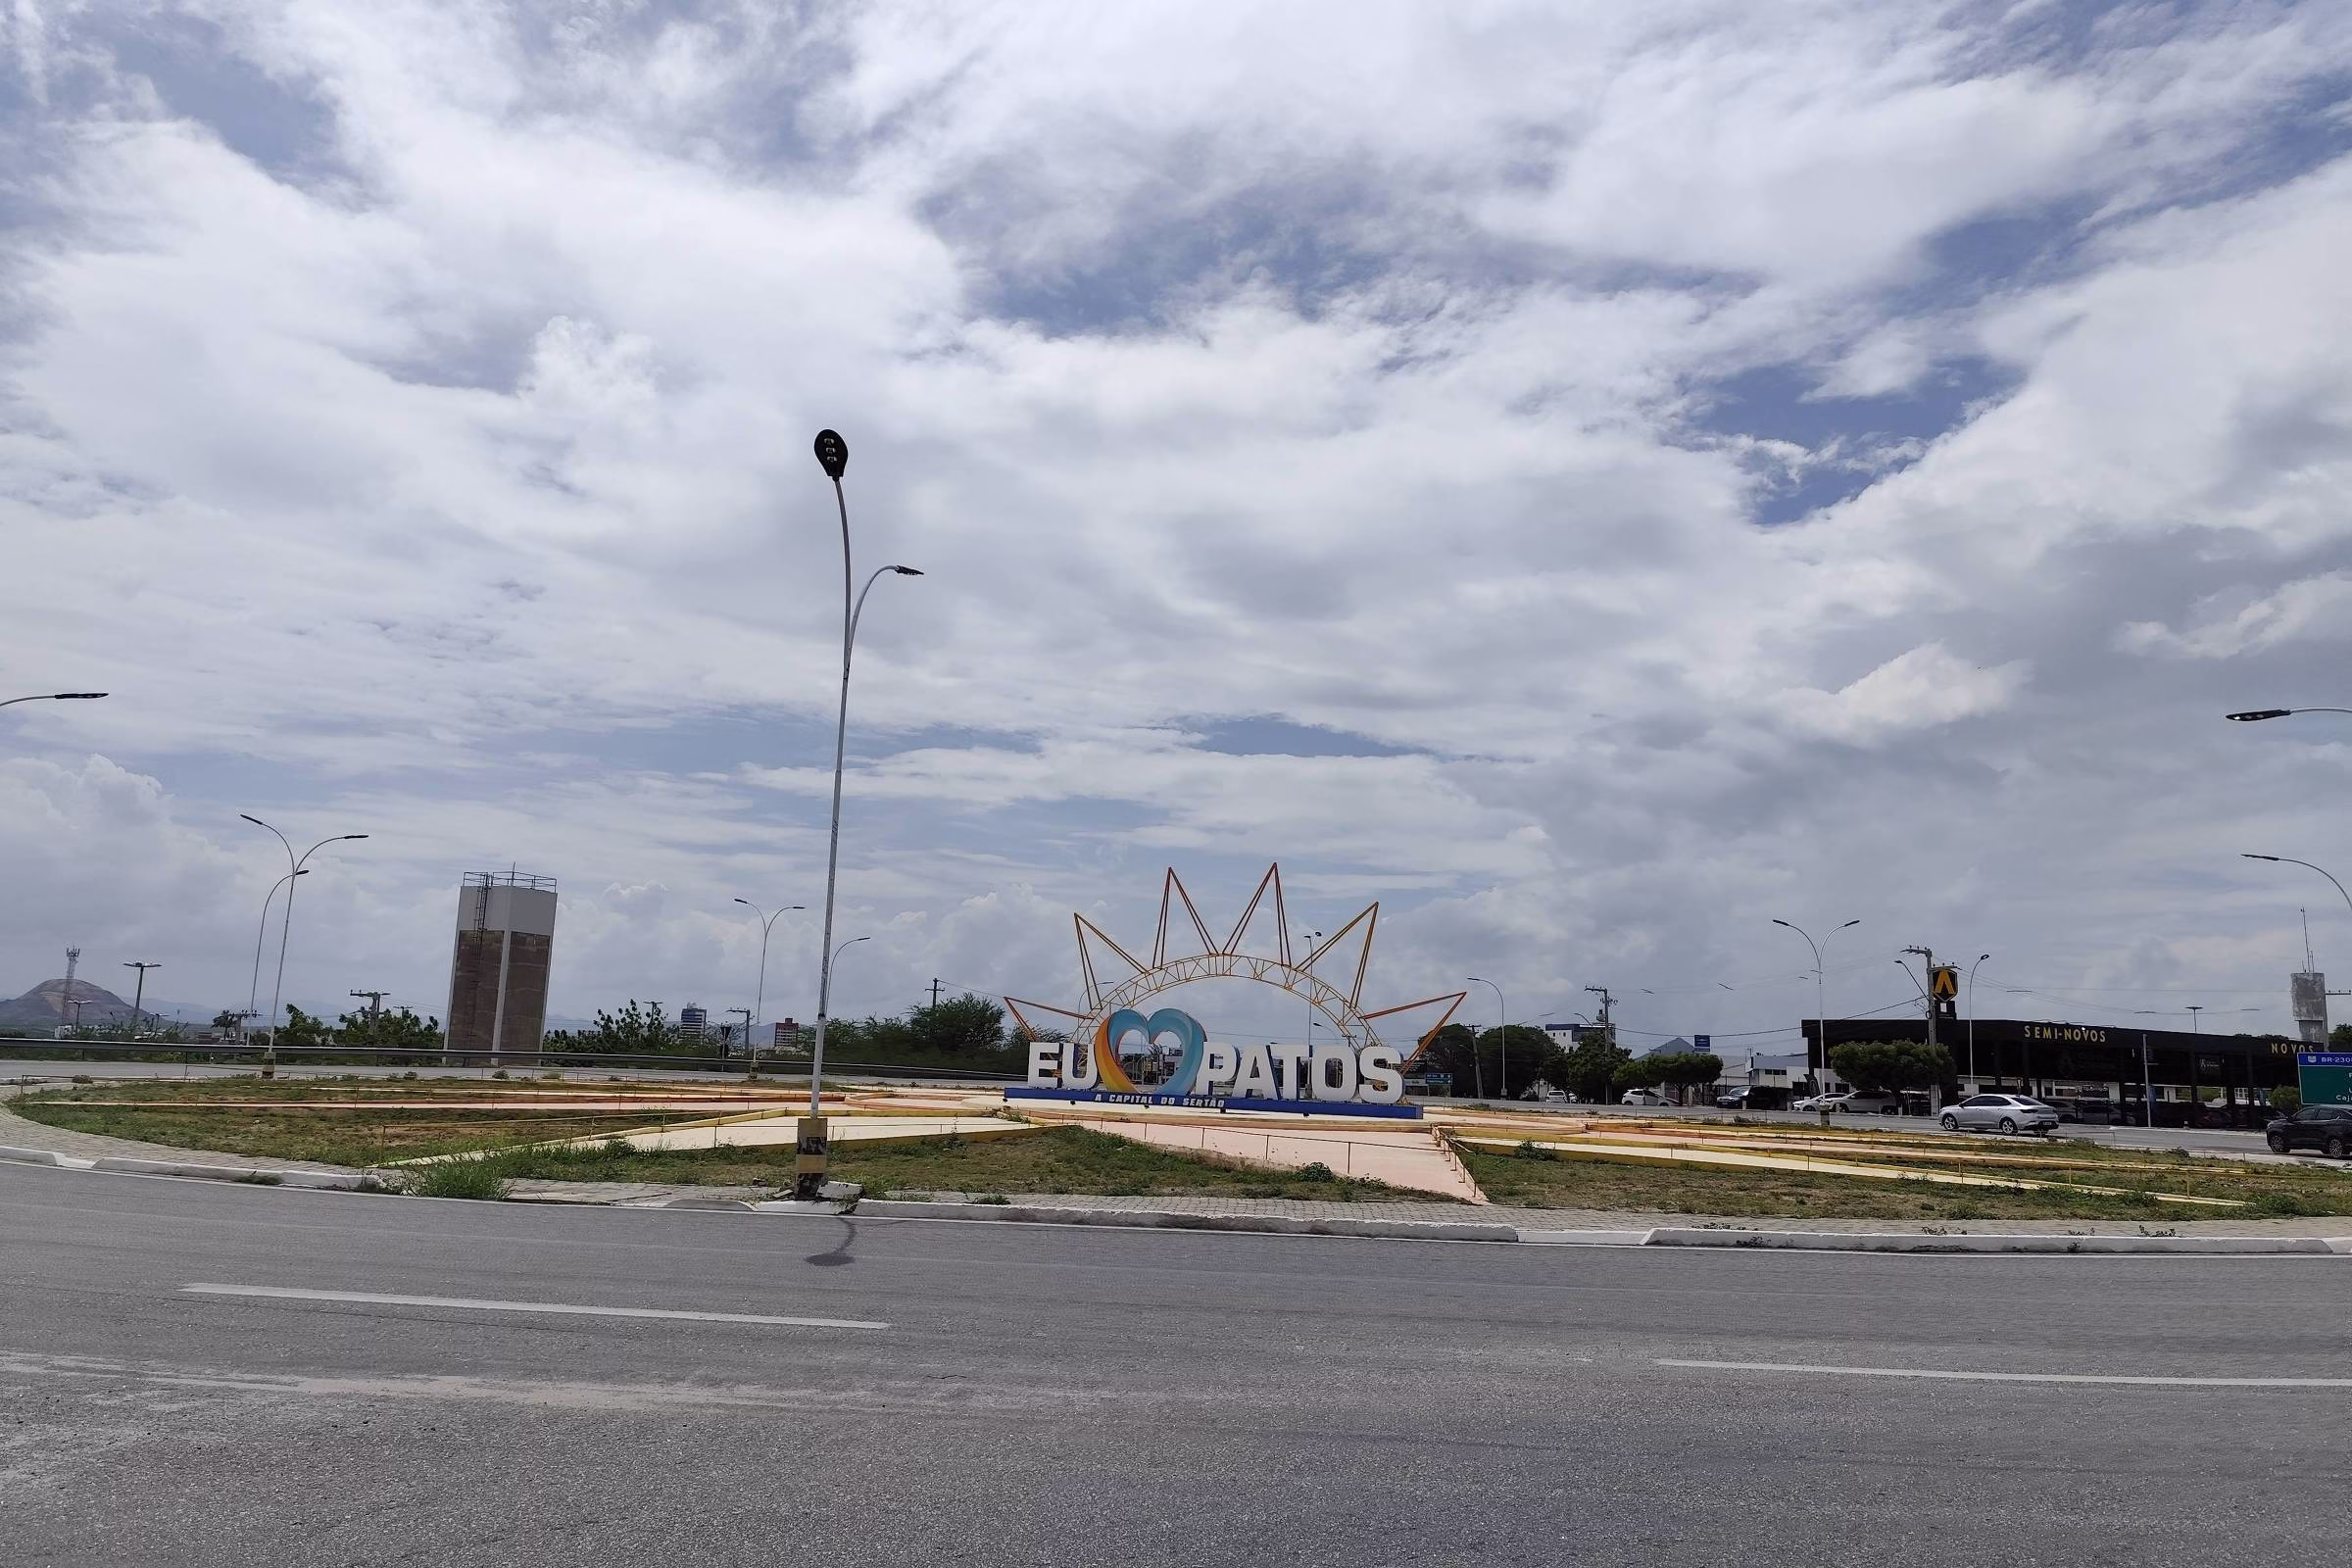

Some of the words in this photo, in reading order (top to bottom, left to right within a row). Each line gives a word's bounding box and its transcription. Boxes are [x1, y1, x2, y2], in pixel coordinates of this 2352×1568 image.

[2024, 1025, 2106, 1043] SEMI-NOVOS
[2271, 1042, 2314, 1054] NOVOS
[1027, 1041, 1100, 1091] EU
[1195, 1041, 1404, 1104] PATOS
[1108, 1094, 1153, 1104] CAPITAL
[1160, 1097, 1176, 1105] DO
[1183, 1097, 1225, 1108] SERTÃO
